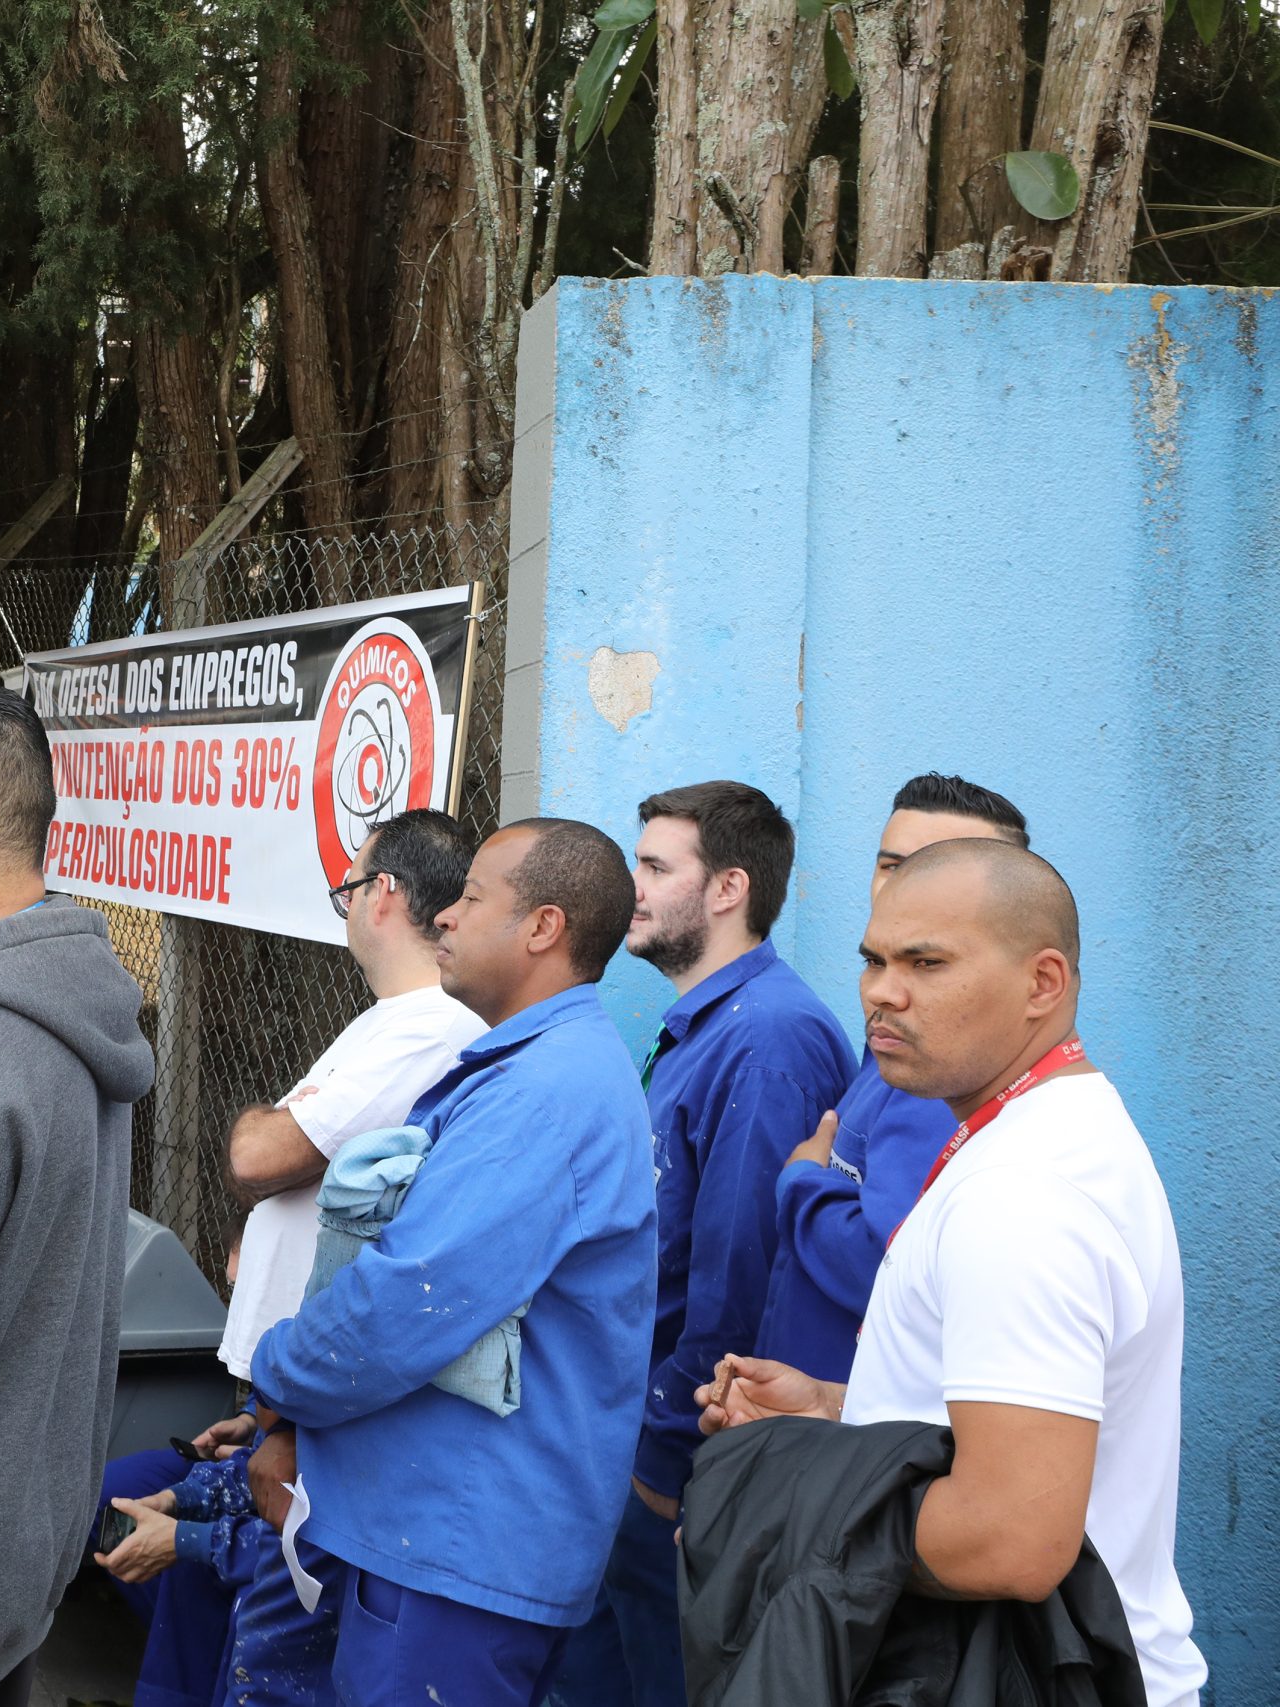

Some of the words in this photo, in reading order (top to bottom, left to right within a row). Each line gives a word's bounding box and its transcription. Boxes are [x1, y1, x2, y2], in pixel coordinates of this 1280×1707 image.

[58, 663, 120, 717] DEFESA
[124, 657, 165, 714] DOS
[169, 640, 304, 717] EMPREGOS,
[337, 643, 417, 708] QUÍMICOS
[52, 723, 165, 820] ANUTENÇÃO
[172, 739, 223, 806] DOS
[231, 737, 302, 811] 30%
[44, 820, 232, 905] PERICULOSIDADE
[949, 1125, 970, 1150] BASF
